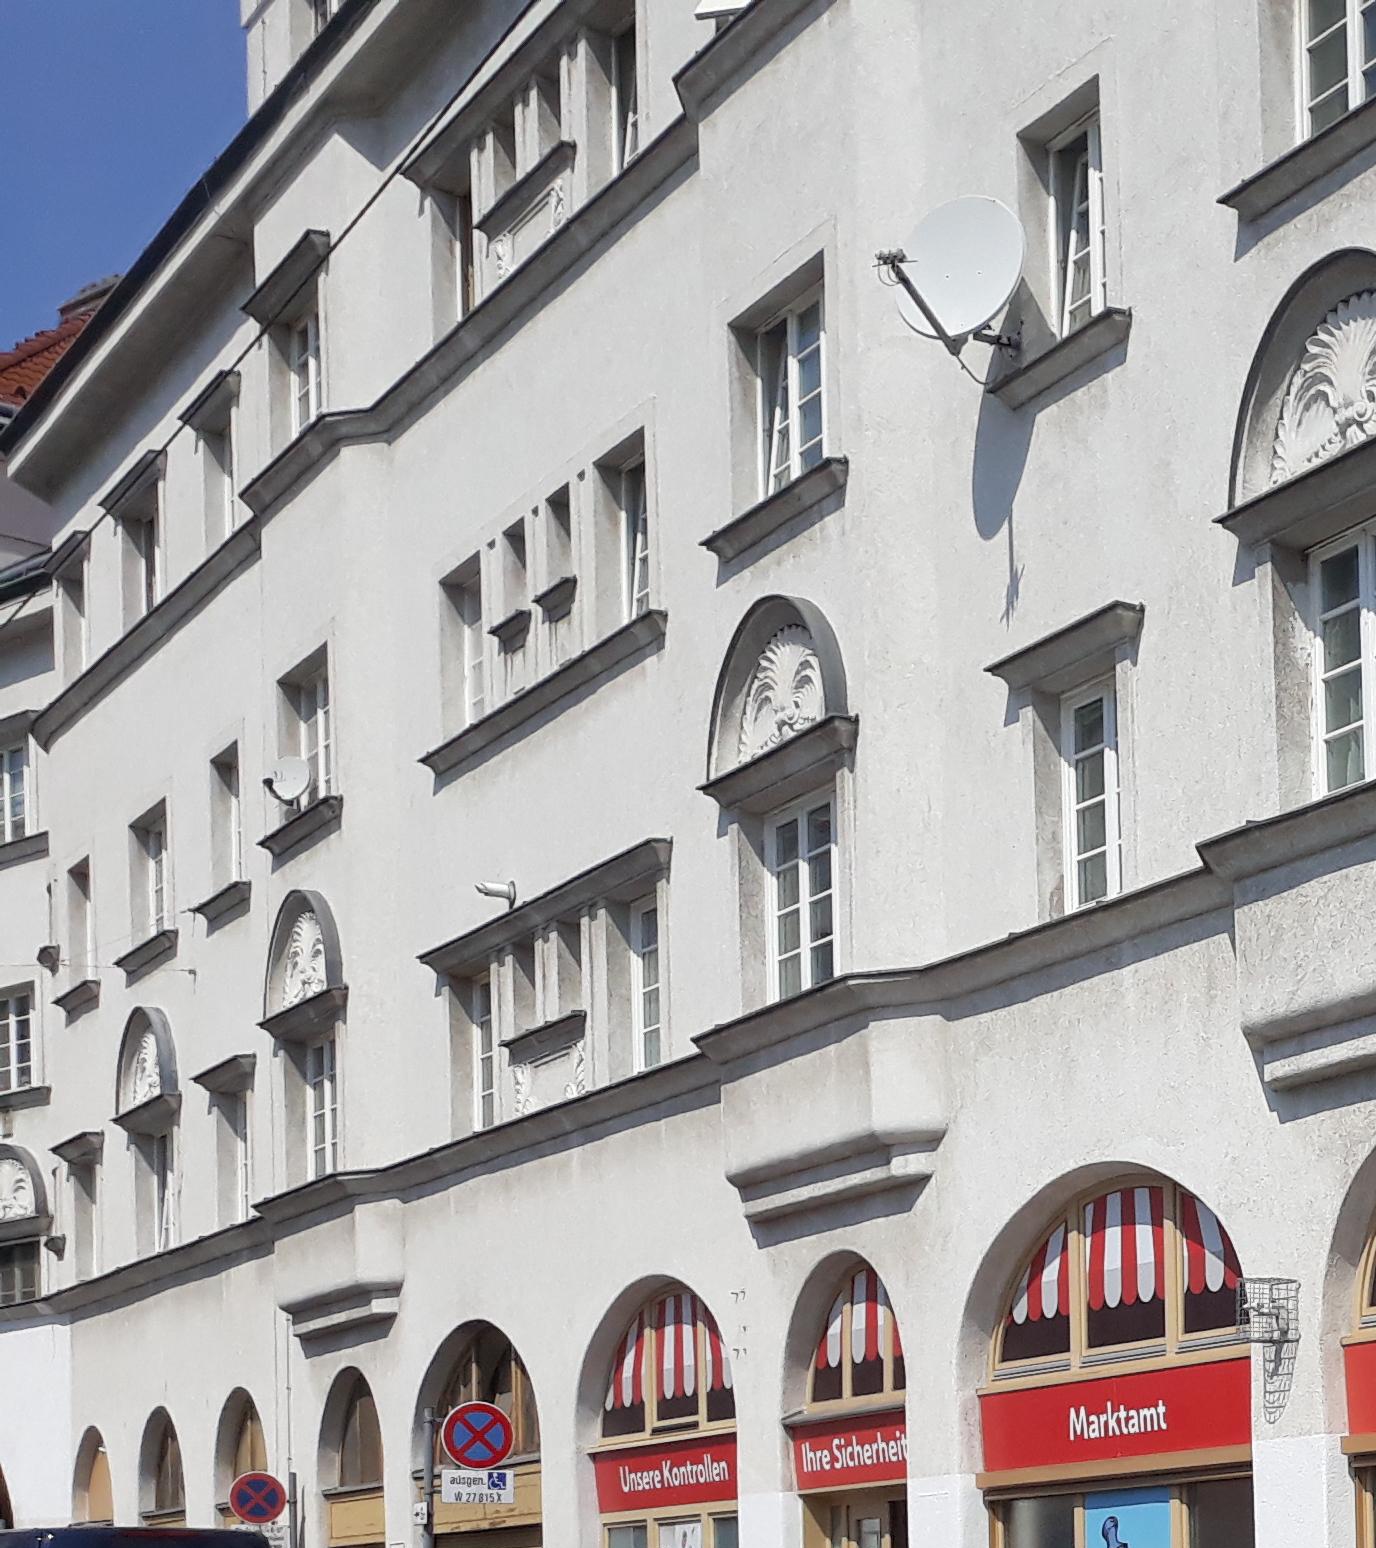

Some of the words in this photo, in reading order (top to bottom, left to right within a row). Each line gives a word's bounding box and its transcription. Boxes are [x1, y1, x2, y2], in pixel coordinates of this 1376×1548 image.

[1069, 1399, 1168, 1441] Marktamt
[801, 1441, 831, 1473] Ihre
[832, 1430, 908, 1470] Sicherheit
[619, 1465, 661, 1493] Unsere
[661, 1453, 729, 1488] Kontrollen
